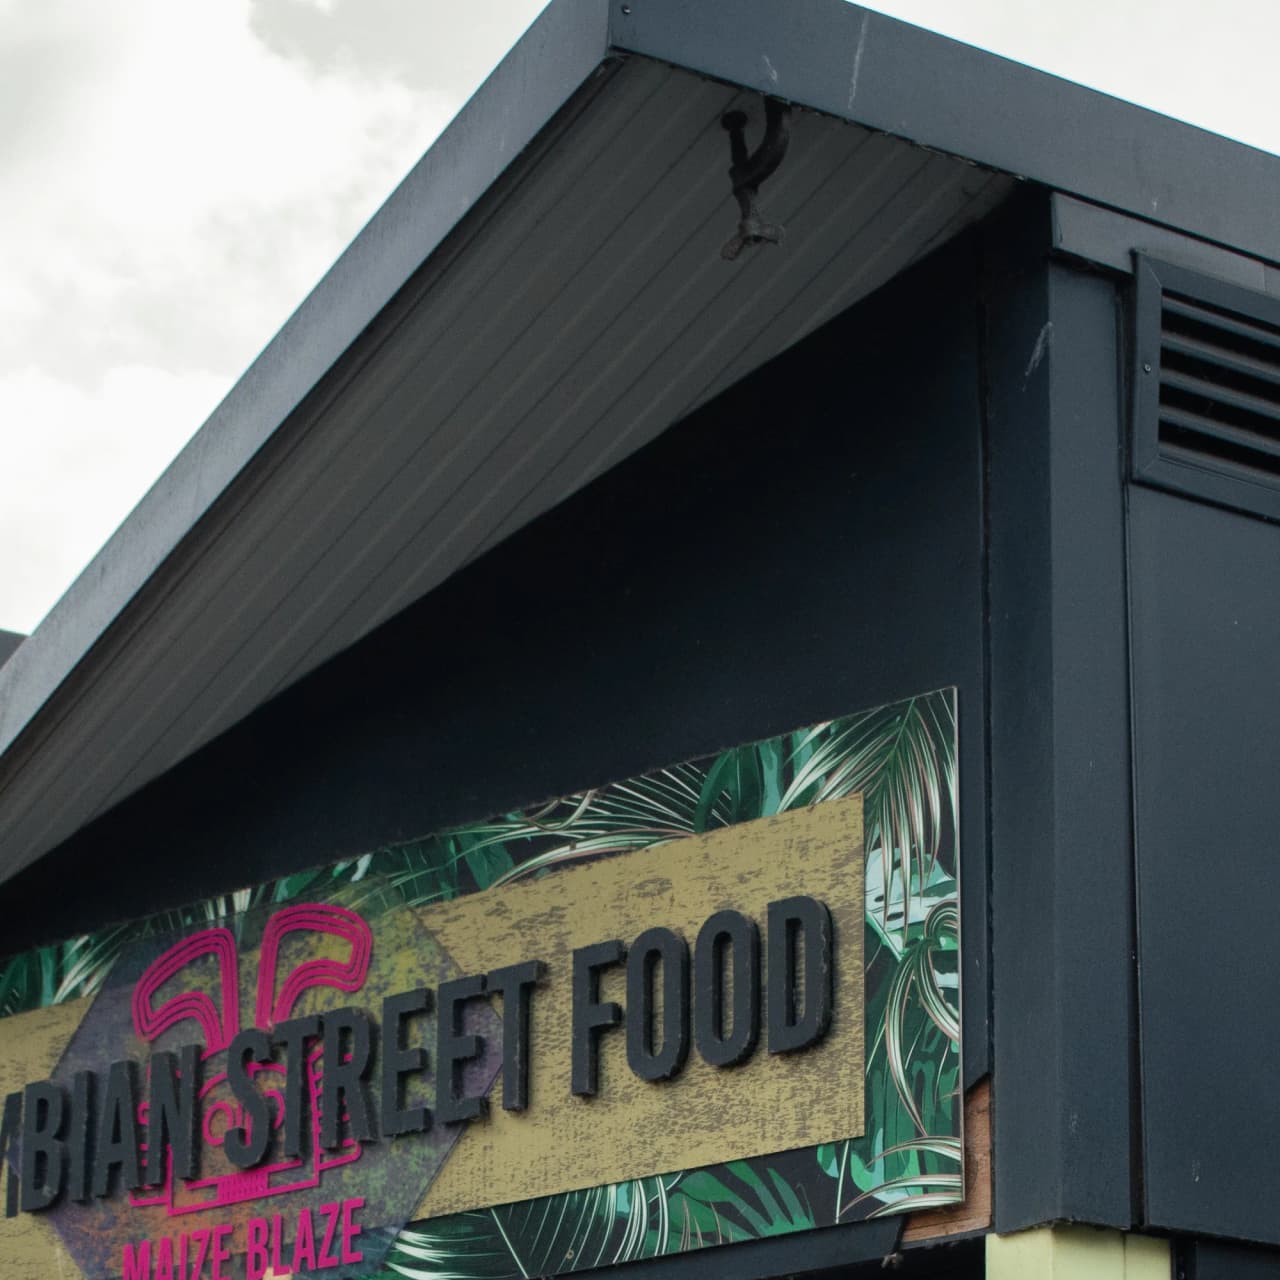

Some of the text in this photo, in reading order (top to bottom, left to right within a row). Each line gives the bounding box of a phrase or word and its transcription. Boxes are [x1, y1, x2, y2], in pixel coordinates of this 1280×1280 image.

[222, 957, 548, 1172] STREET
[570, 894, 834, 1098] FOOD
[246, 1198, 364, 1278] BLAZE
